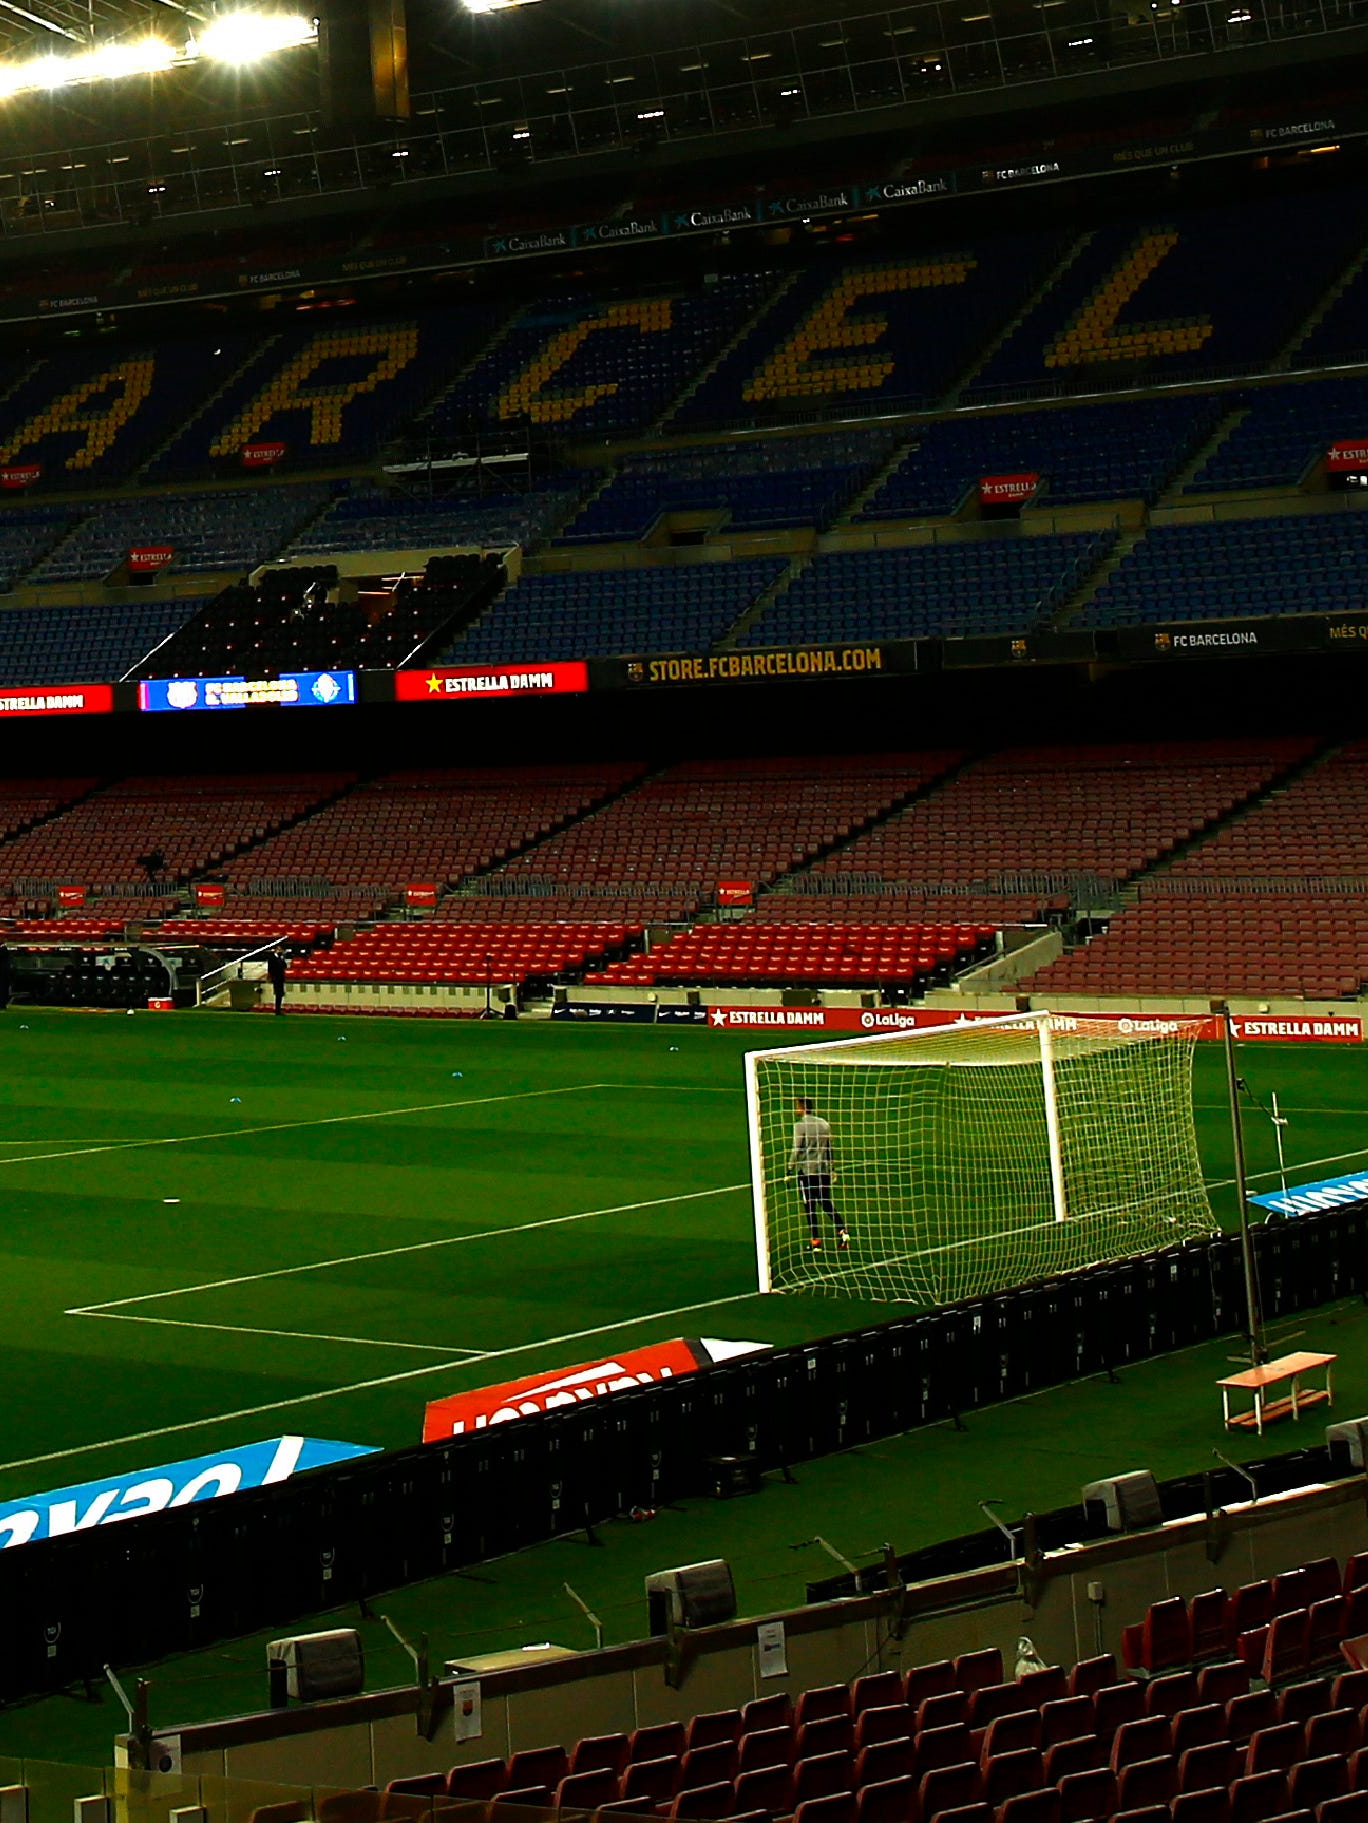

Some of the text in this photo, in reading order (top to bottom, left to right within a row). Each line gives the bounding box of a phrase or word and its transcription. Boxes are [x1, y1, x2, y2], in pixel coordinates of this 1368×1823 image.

[1265, 119, 1336, 138] FC BARCELONA
[997, 162, 1060, 180] FC BARCELONA
[882, 179, 948, 199] CaixaBank
[786, 194, 849, 214] CaixaBank
[691, 208, 752, 227] CaixaBank
[599, 222, 659, 239] CaixaBank
[508, 233, 567, 251] CaixaBank
[1173, 631, 1258, 648] FC BARCELONA
[1329, 623, 1357, 640] MÉS
[649, 647, 883, 682] STORE.FCBARCELONA.COM
[445, 672, 553, 693] ESTRELLA DAMM
[46, 694, 84, 709] DAMM
[729, 1011, 824, 1025] ESTRELLA DAMM
[875, 1013, 915, 1028] LaLiga
[1244, 1022, 1358, 1036] ESTRELLA DAMM
